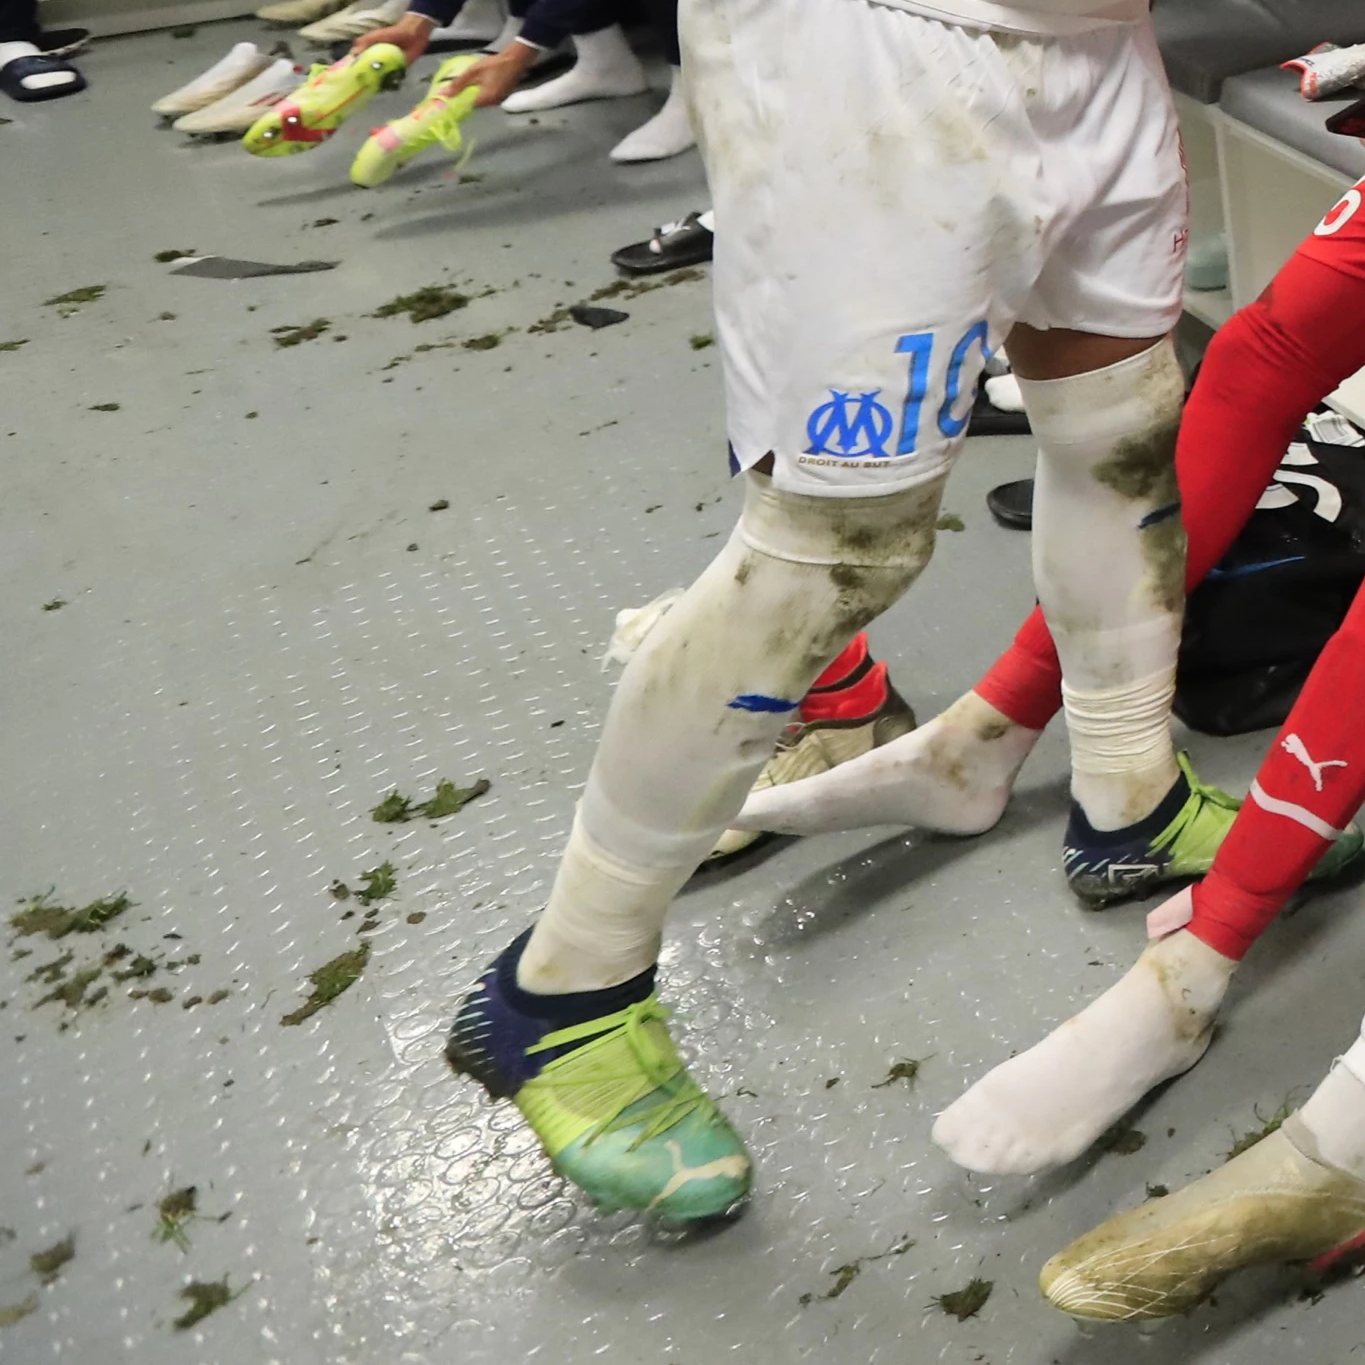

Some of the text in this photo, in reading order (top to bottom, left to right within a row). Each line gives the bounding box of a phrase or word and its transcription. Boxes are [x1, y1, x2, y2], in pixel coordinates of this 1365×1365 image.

[798, 456, 891, 469] DROIT AU BUT
